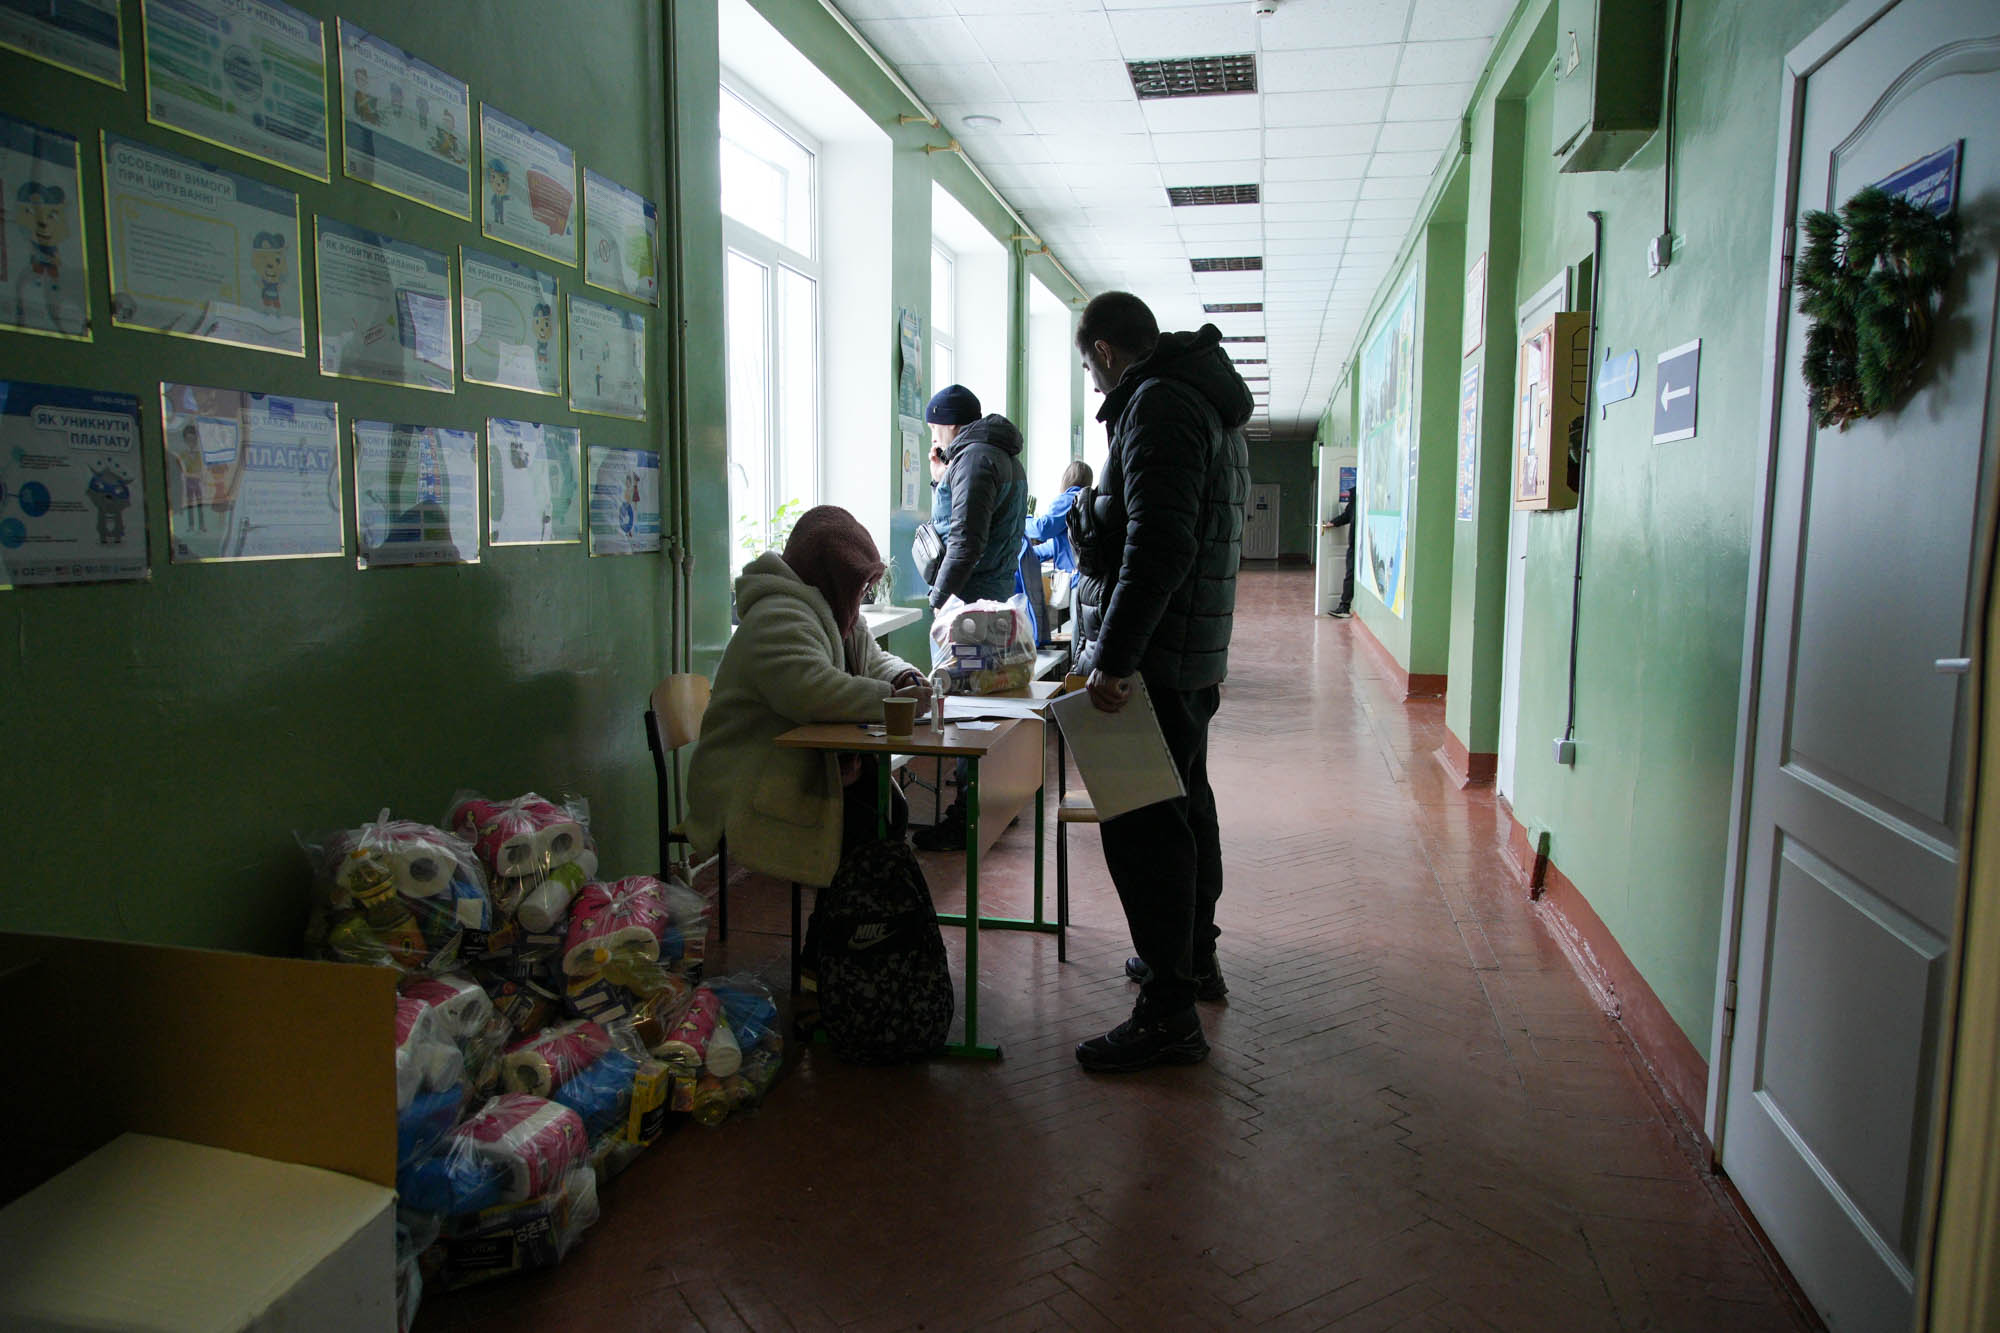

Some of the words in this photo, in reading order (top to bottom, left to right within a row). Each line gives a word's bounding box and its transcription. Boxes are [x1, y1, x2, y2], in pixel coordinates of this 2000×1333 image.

[118, 153, 181, 179] ОСОБЛИВІ
[184, 173, 232, 195] ВИМОГИ
[118, 169, 144, 184] ПРИ
[38, 413, 56, 425] ЯК
[61, 415, 130, 431] УНИКНУТИ
[71, 433, 130, 447] ПЛАГІАТУ
[246, 447, 328, 469] ПЛАГІАТ
[856, 922, 888, 937] NIKE
